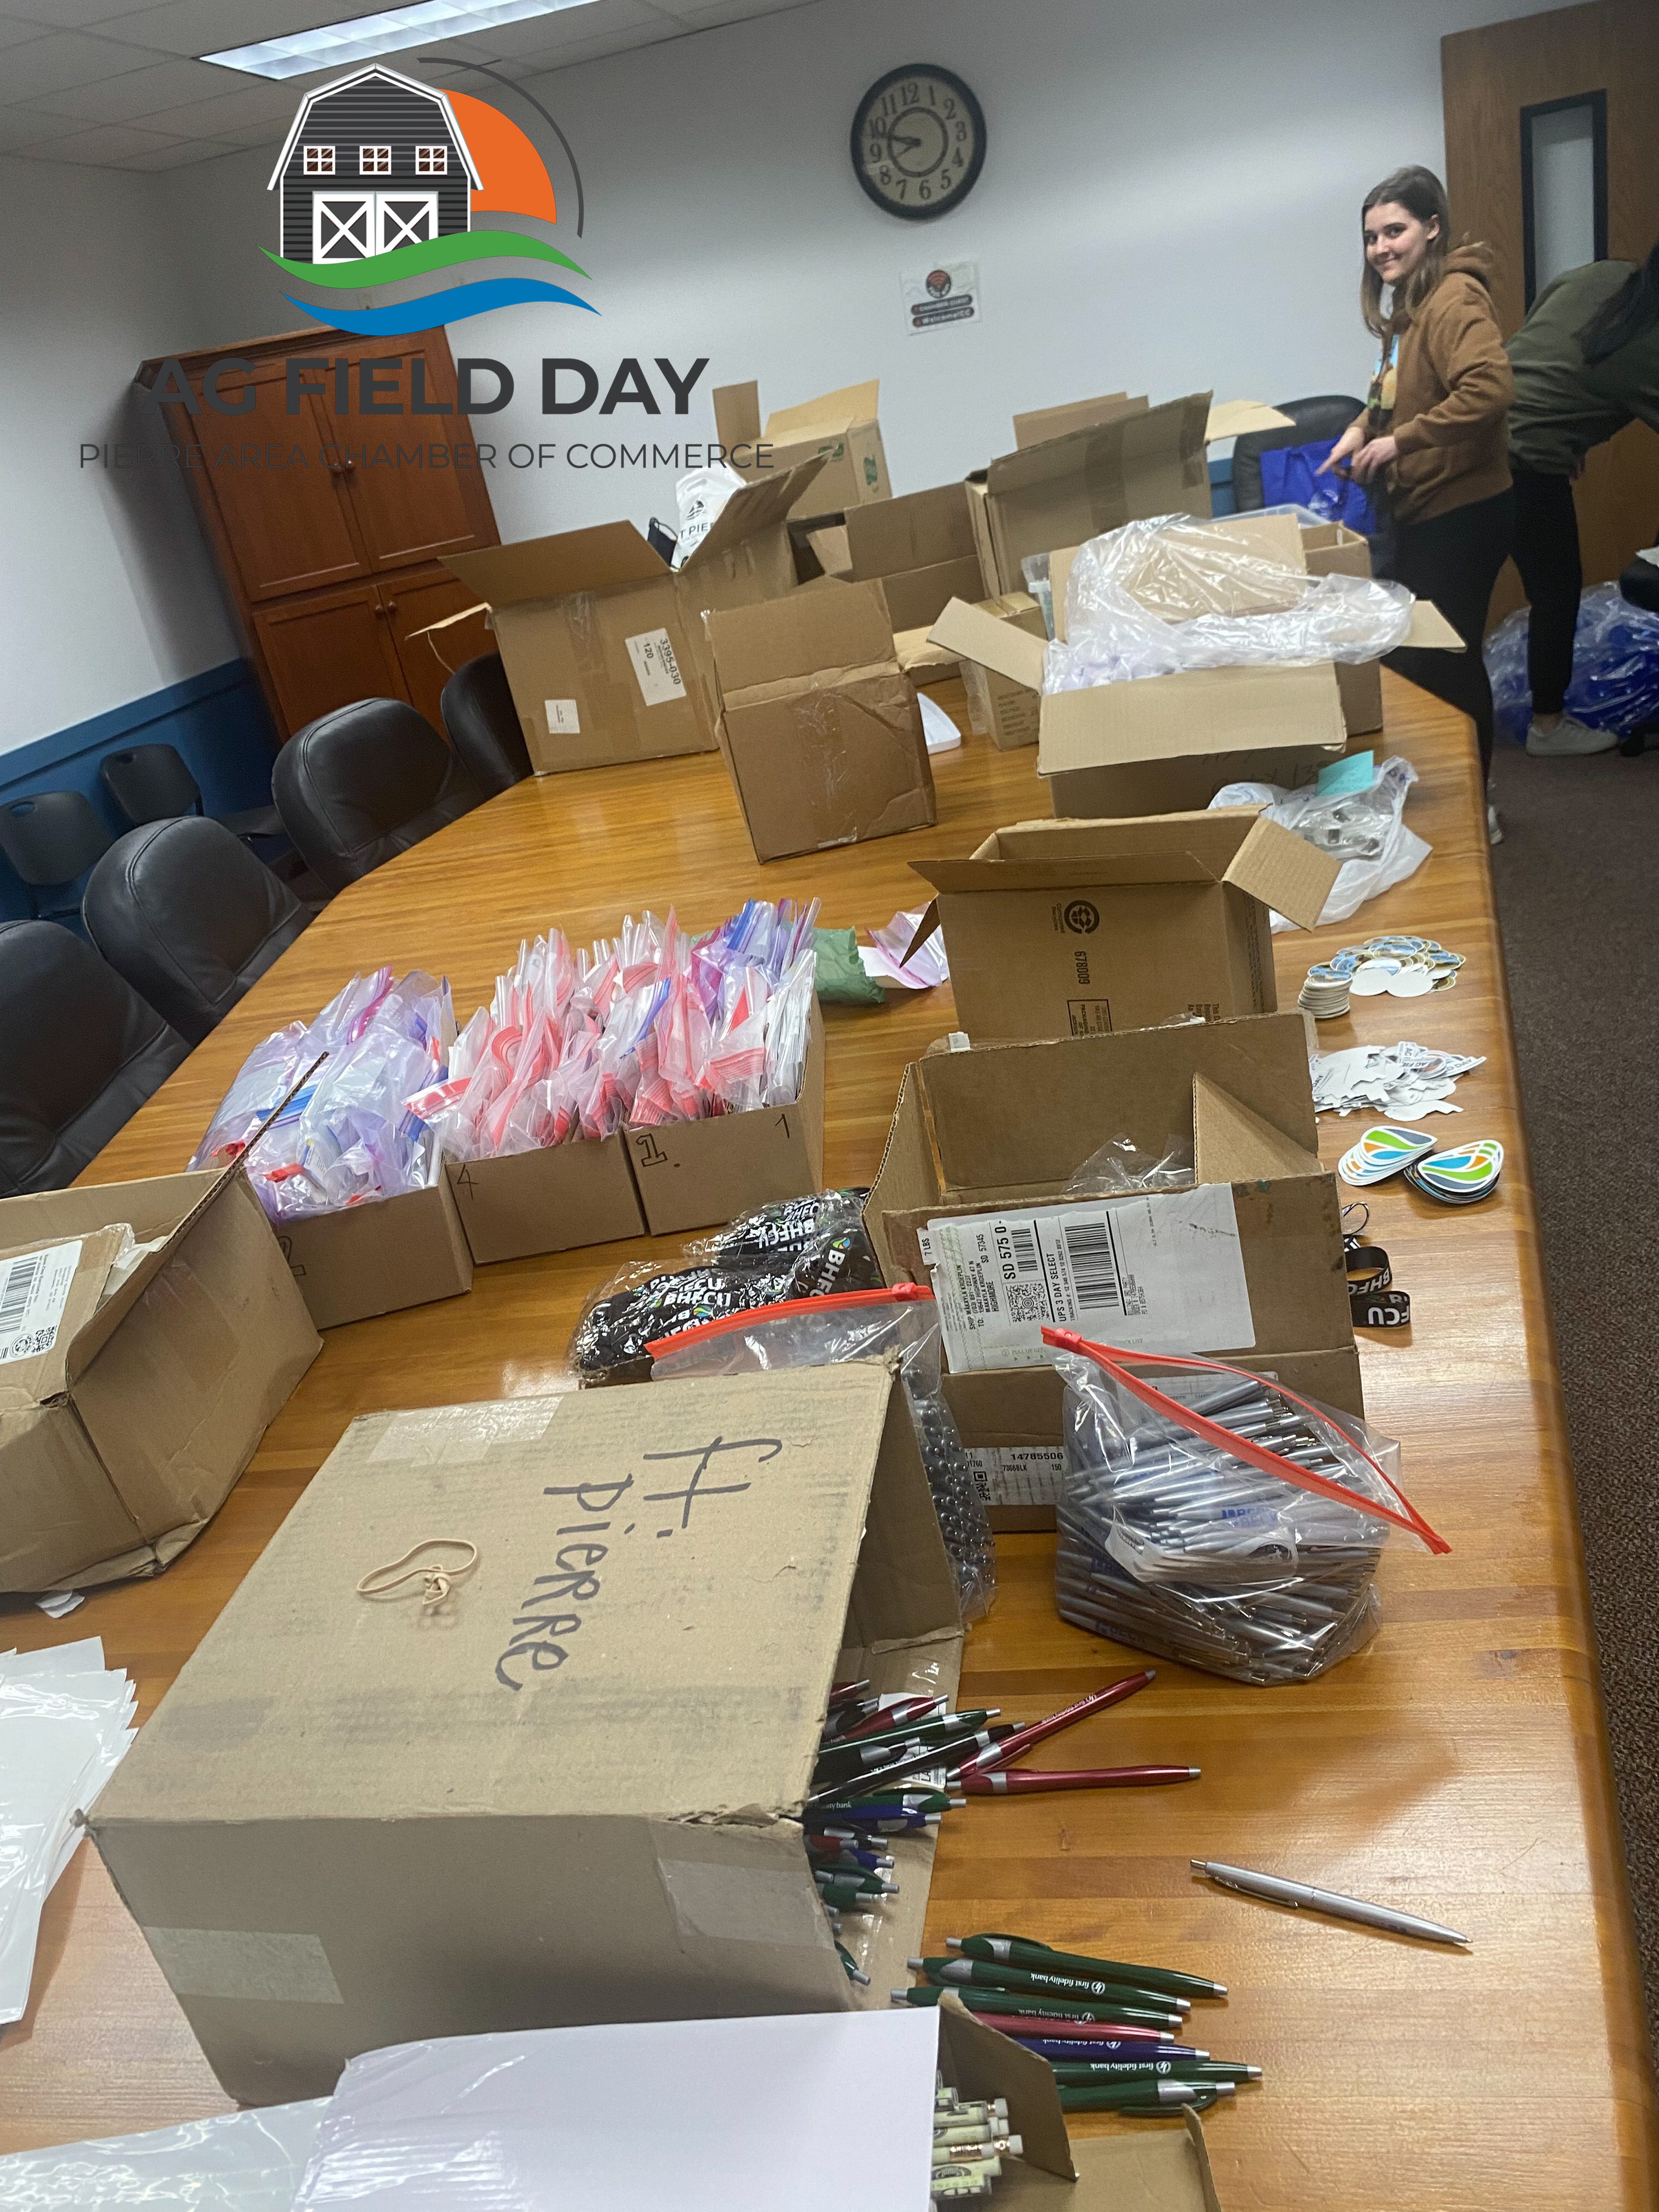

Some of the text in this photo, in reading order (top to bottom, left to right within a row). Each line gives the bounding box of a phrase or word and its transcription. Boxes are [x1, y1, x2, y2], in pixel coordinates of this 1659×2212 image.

[880, 93, 898, 115] 11
[900, 83, 920, 106] 12
[929, 86, 936, 106] 1
[943, 98, 956, 119] 2
[868, 116, 887, 138] 10
[955, 120, 967, 141] 3
[868, 143, 883, 163] 9
[951, 146, 964, 168] 4
[879, 165, 892, 185] 8
[940, 168, 952, 189] 5
[895, 178, 908, 200] 7
[918, 179, 932, 200] 6
[641, 642, 654, 660] 120
[659, 637, 682, 685] 3395-030
[1074, 951, 1090, 984] 678009
[456, 1164, 479, 1200] 4
[922, 1238, 931, 1251] LBS
[977, 1234, 986, 1251] 57345
[997, 1238, 1012, 1259] 575
[1002, 1264, 1016, 1279] SD
[1046, 1253, 1058, 1280] SELECT
[986, 1281, 999, 1312] HIGHMORE
[1052, 1282, 1062, 1297] DAY
[1057, 1307, 1066, 1322] UPS
[1067, 1299, 1075, 1321] TRACKING
[1011, 1452, 1064, 1460] 14785506
[1031, 1973, 1090, 1989] first fidelity bank
[1110, 2063, 1136, 2071] fidelity
